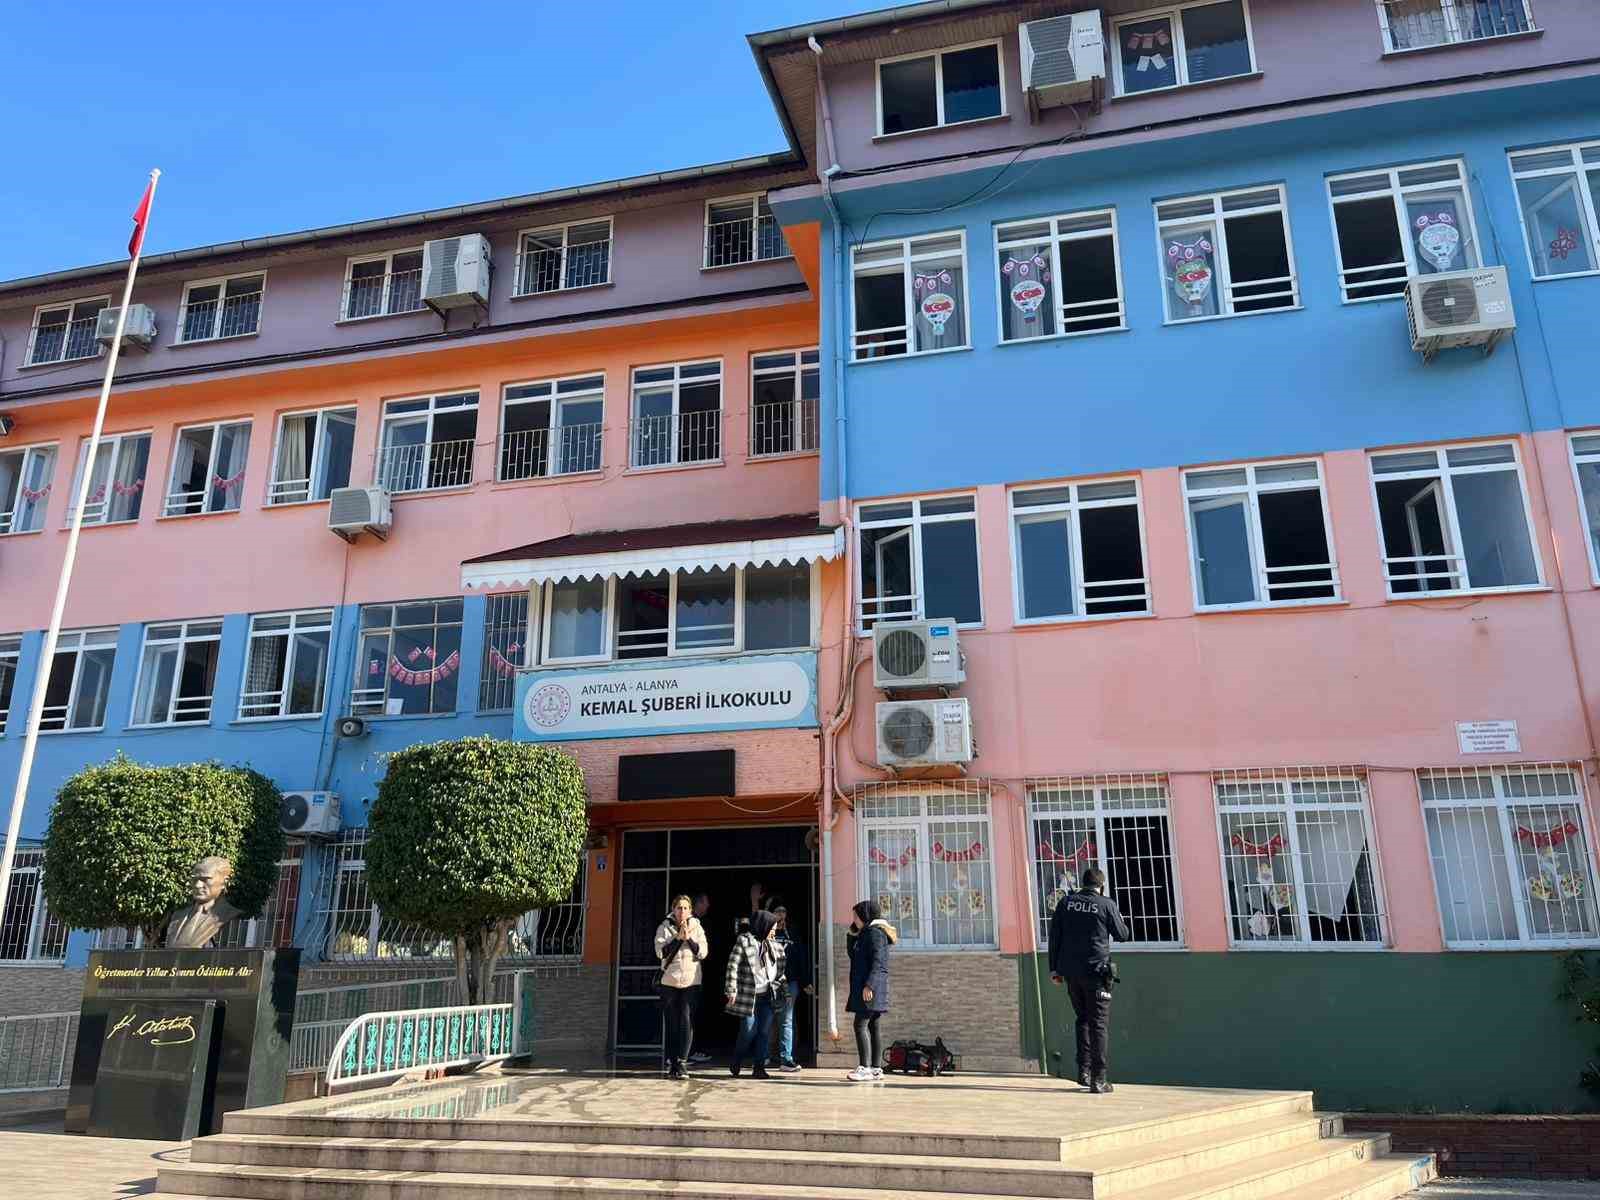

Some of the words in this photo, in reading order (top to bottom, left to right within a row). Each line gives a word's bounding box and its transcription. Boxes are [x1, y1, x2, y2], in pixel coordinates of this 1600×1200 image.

[581, 683, 628, 696] ANTALYA
[636, 679, 679, 692] ALANYA
[580, 698, 637, 717] KEMAL
[641, 693, 701, 716] ŞUBERİ
[705, 690, 792, 711] İLKOKULU
[94, 965, 144, 979] Öğretmenler
[196, 964, 234, 977] Ödülünü
